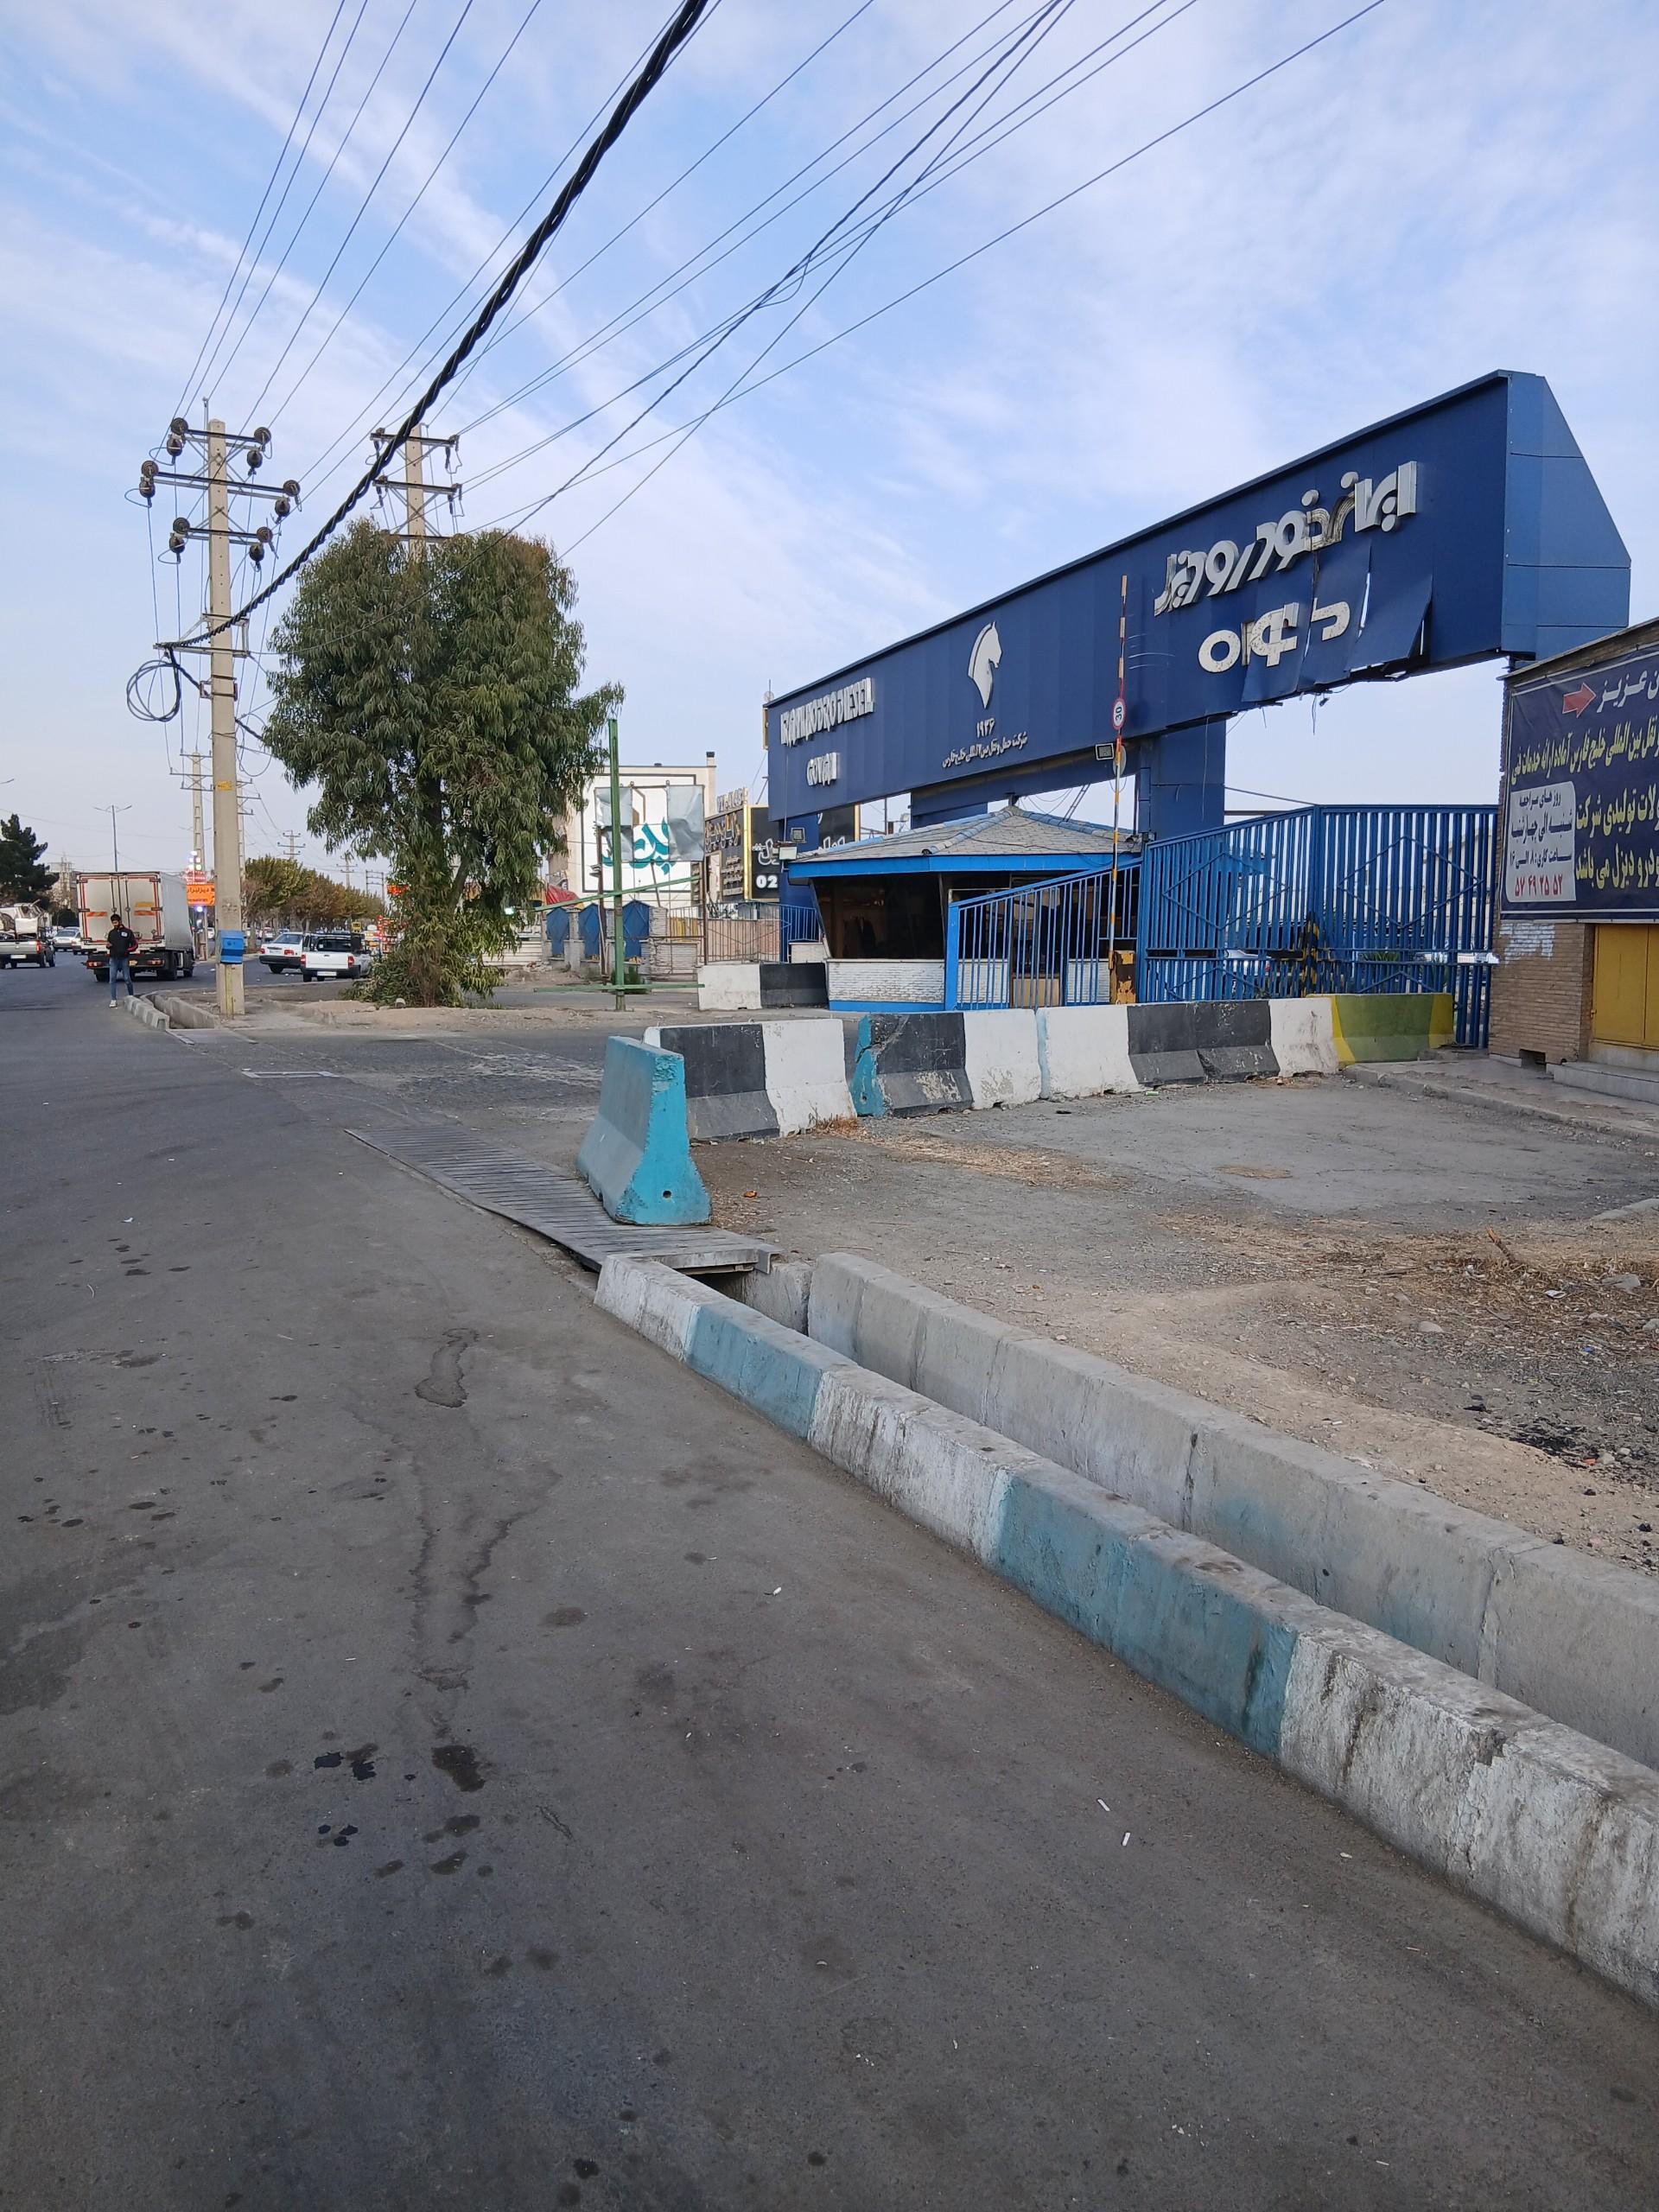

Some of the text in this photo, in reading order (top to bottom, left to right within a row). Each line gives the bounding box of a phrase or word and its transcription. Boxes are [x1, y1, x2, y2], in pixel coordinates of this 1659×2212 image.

[1596, 670, 1648, 713] عزیز
[1115, 706, 1122, 721] 30
[1576, 794, 1602, 838] شرکت
[1603, 787, 1637, 836] تولیدی
[1575, 846, 1594, 888] باشد
[1596, 858, 1610, 889] می
[1611, 842, 1635, 889] دیزل
